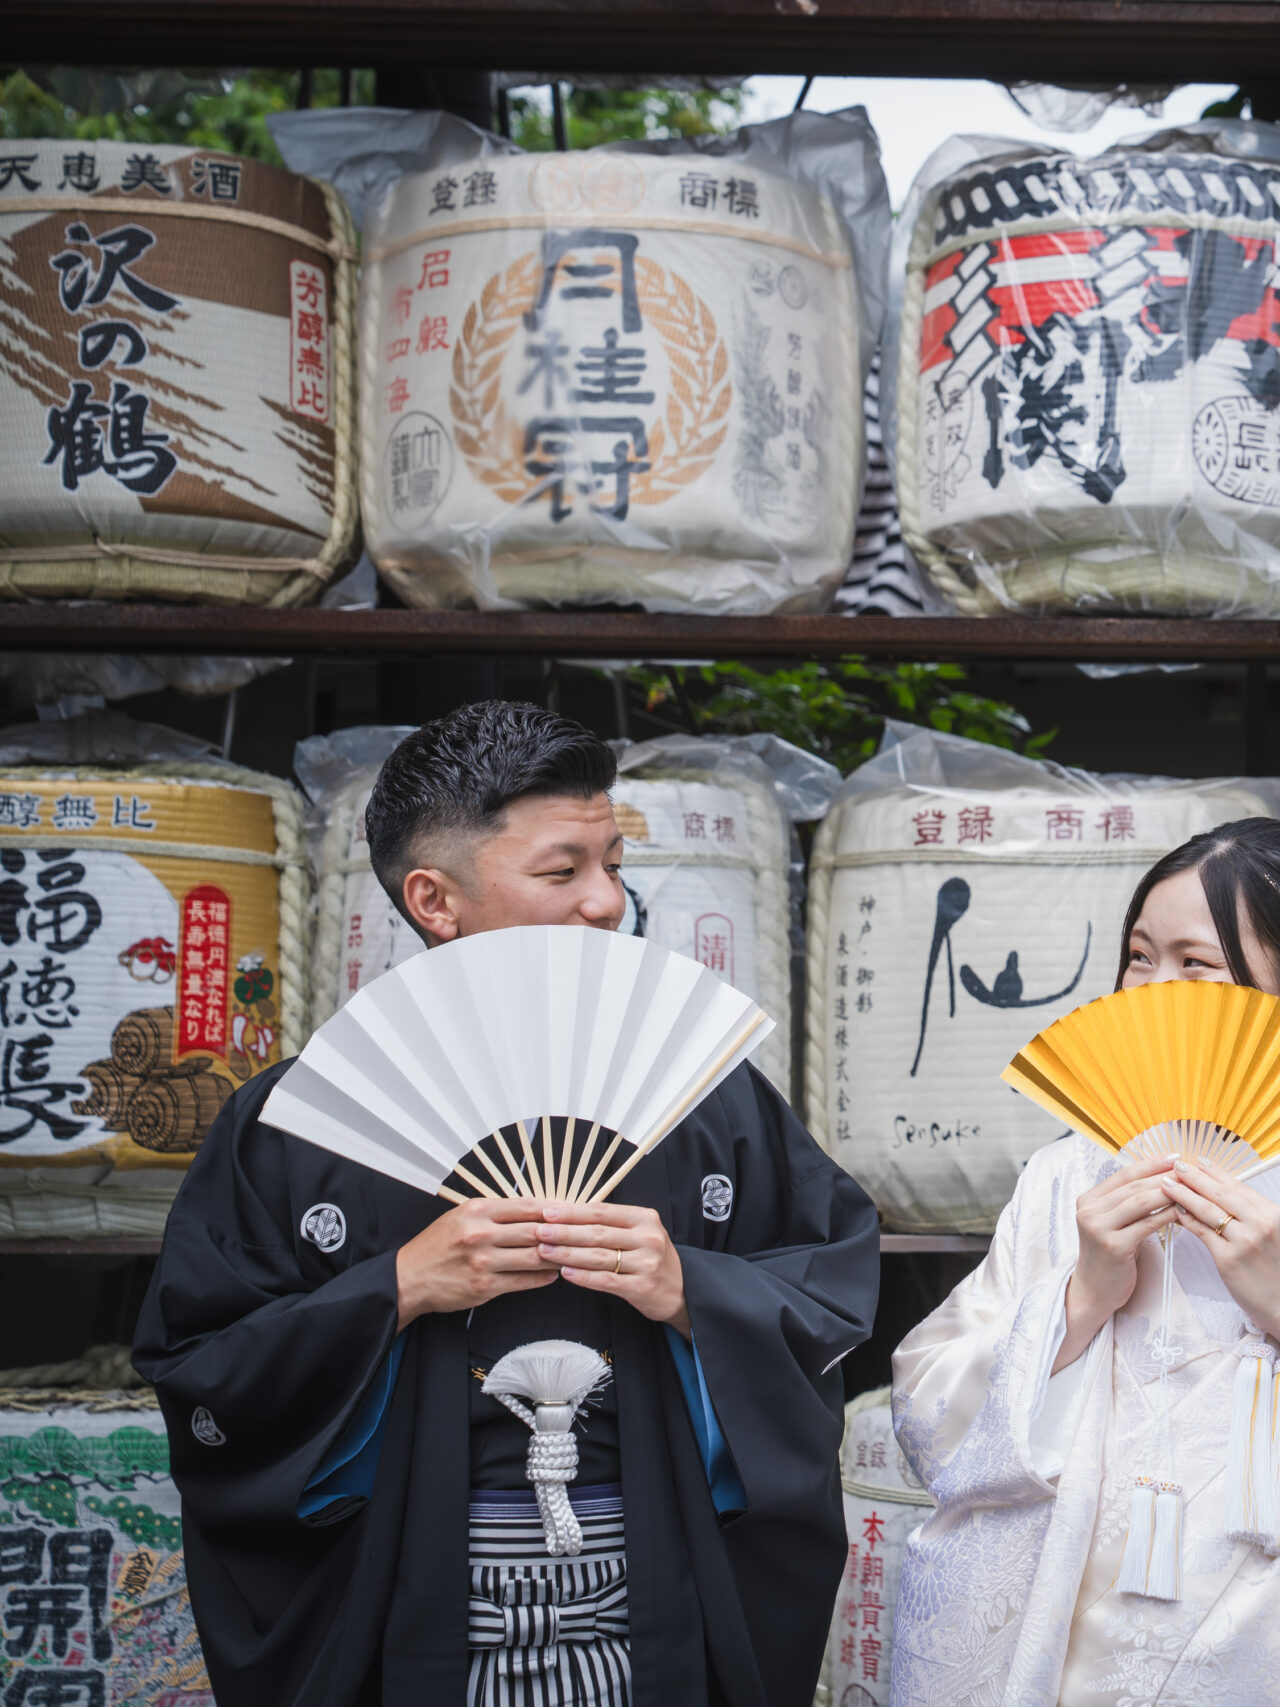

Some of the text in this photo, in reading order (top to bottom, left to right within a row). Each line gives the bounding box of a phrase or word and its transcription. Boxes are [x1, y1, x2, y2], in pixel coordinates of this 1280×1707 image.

[44, 222, 182, 494] 沢の鶴
[296, 271, 326, 414] 芳醇無比
[516, 228, 656, 524] 月桂冠
[682, 812, 737, 843] 商標
[912, 804, 1137, 846] 登録 商標
[909, 877, 1093, 1077] 仙
